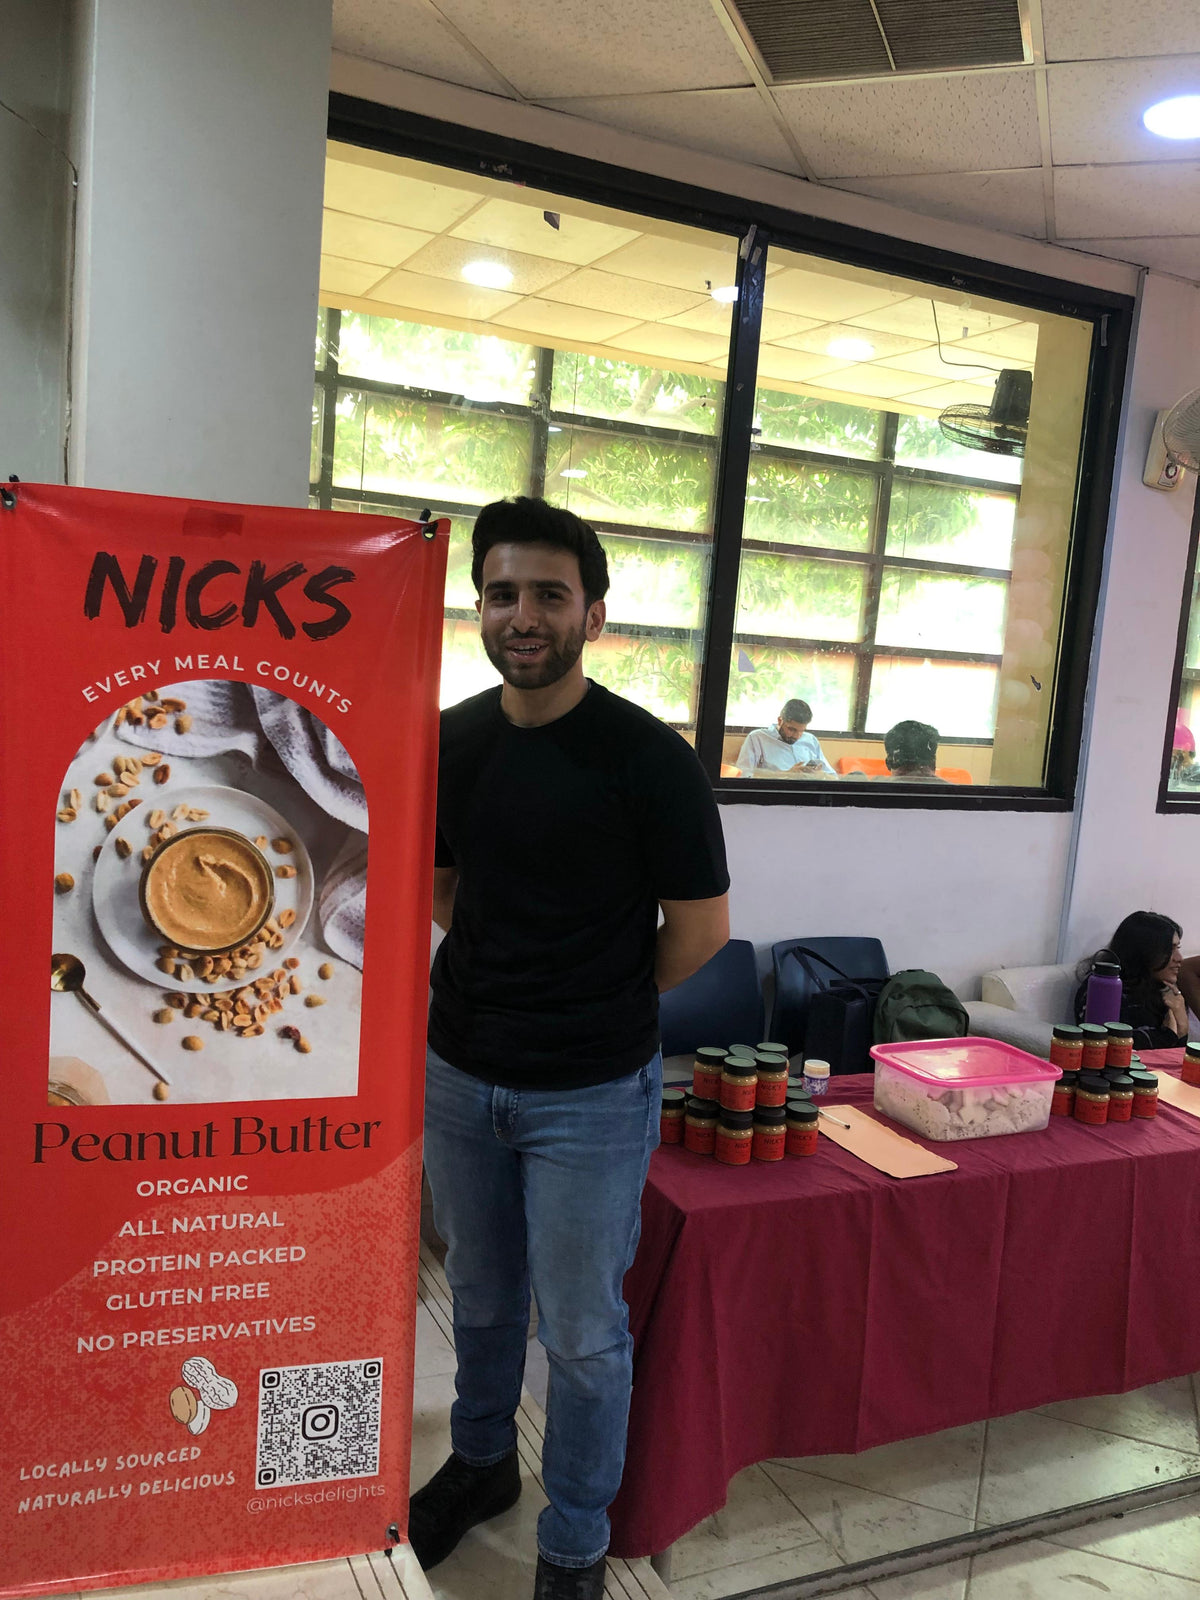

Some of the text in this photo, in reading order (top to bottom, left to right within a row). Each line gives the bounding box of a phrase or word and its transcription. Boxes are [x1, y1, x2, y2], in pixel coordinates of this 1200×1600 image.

[83, 551, 357, 642] NICKS
[81, 654, 353, 714] EVERY MEAL COUNTS
[32, 1115, 382, 1164] Peanut Butter
[135, 1175, 249, 1197] ORGANIC
[118, 1211, 285, 1238] ALL NATURAL
[93, 1246, 307, 1278] PROTEIN PACKED
[105, 1282, 270, 1311] GLUTEN FREE
[76, 1315, 316, 1354] NO PRESERVATIVES
[19, 1446, 202, 1482] LOCALLY SOURCED
[17, 1471, 236, 1514] NATURALLY DELICIOUS
[246, 1482, 386, 1515] @nicksdelights
